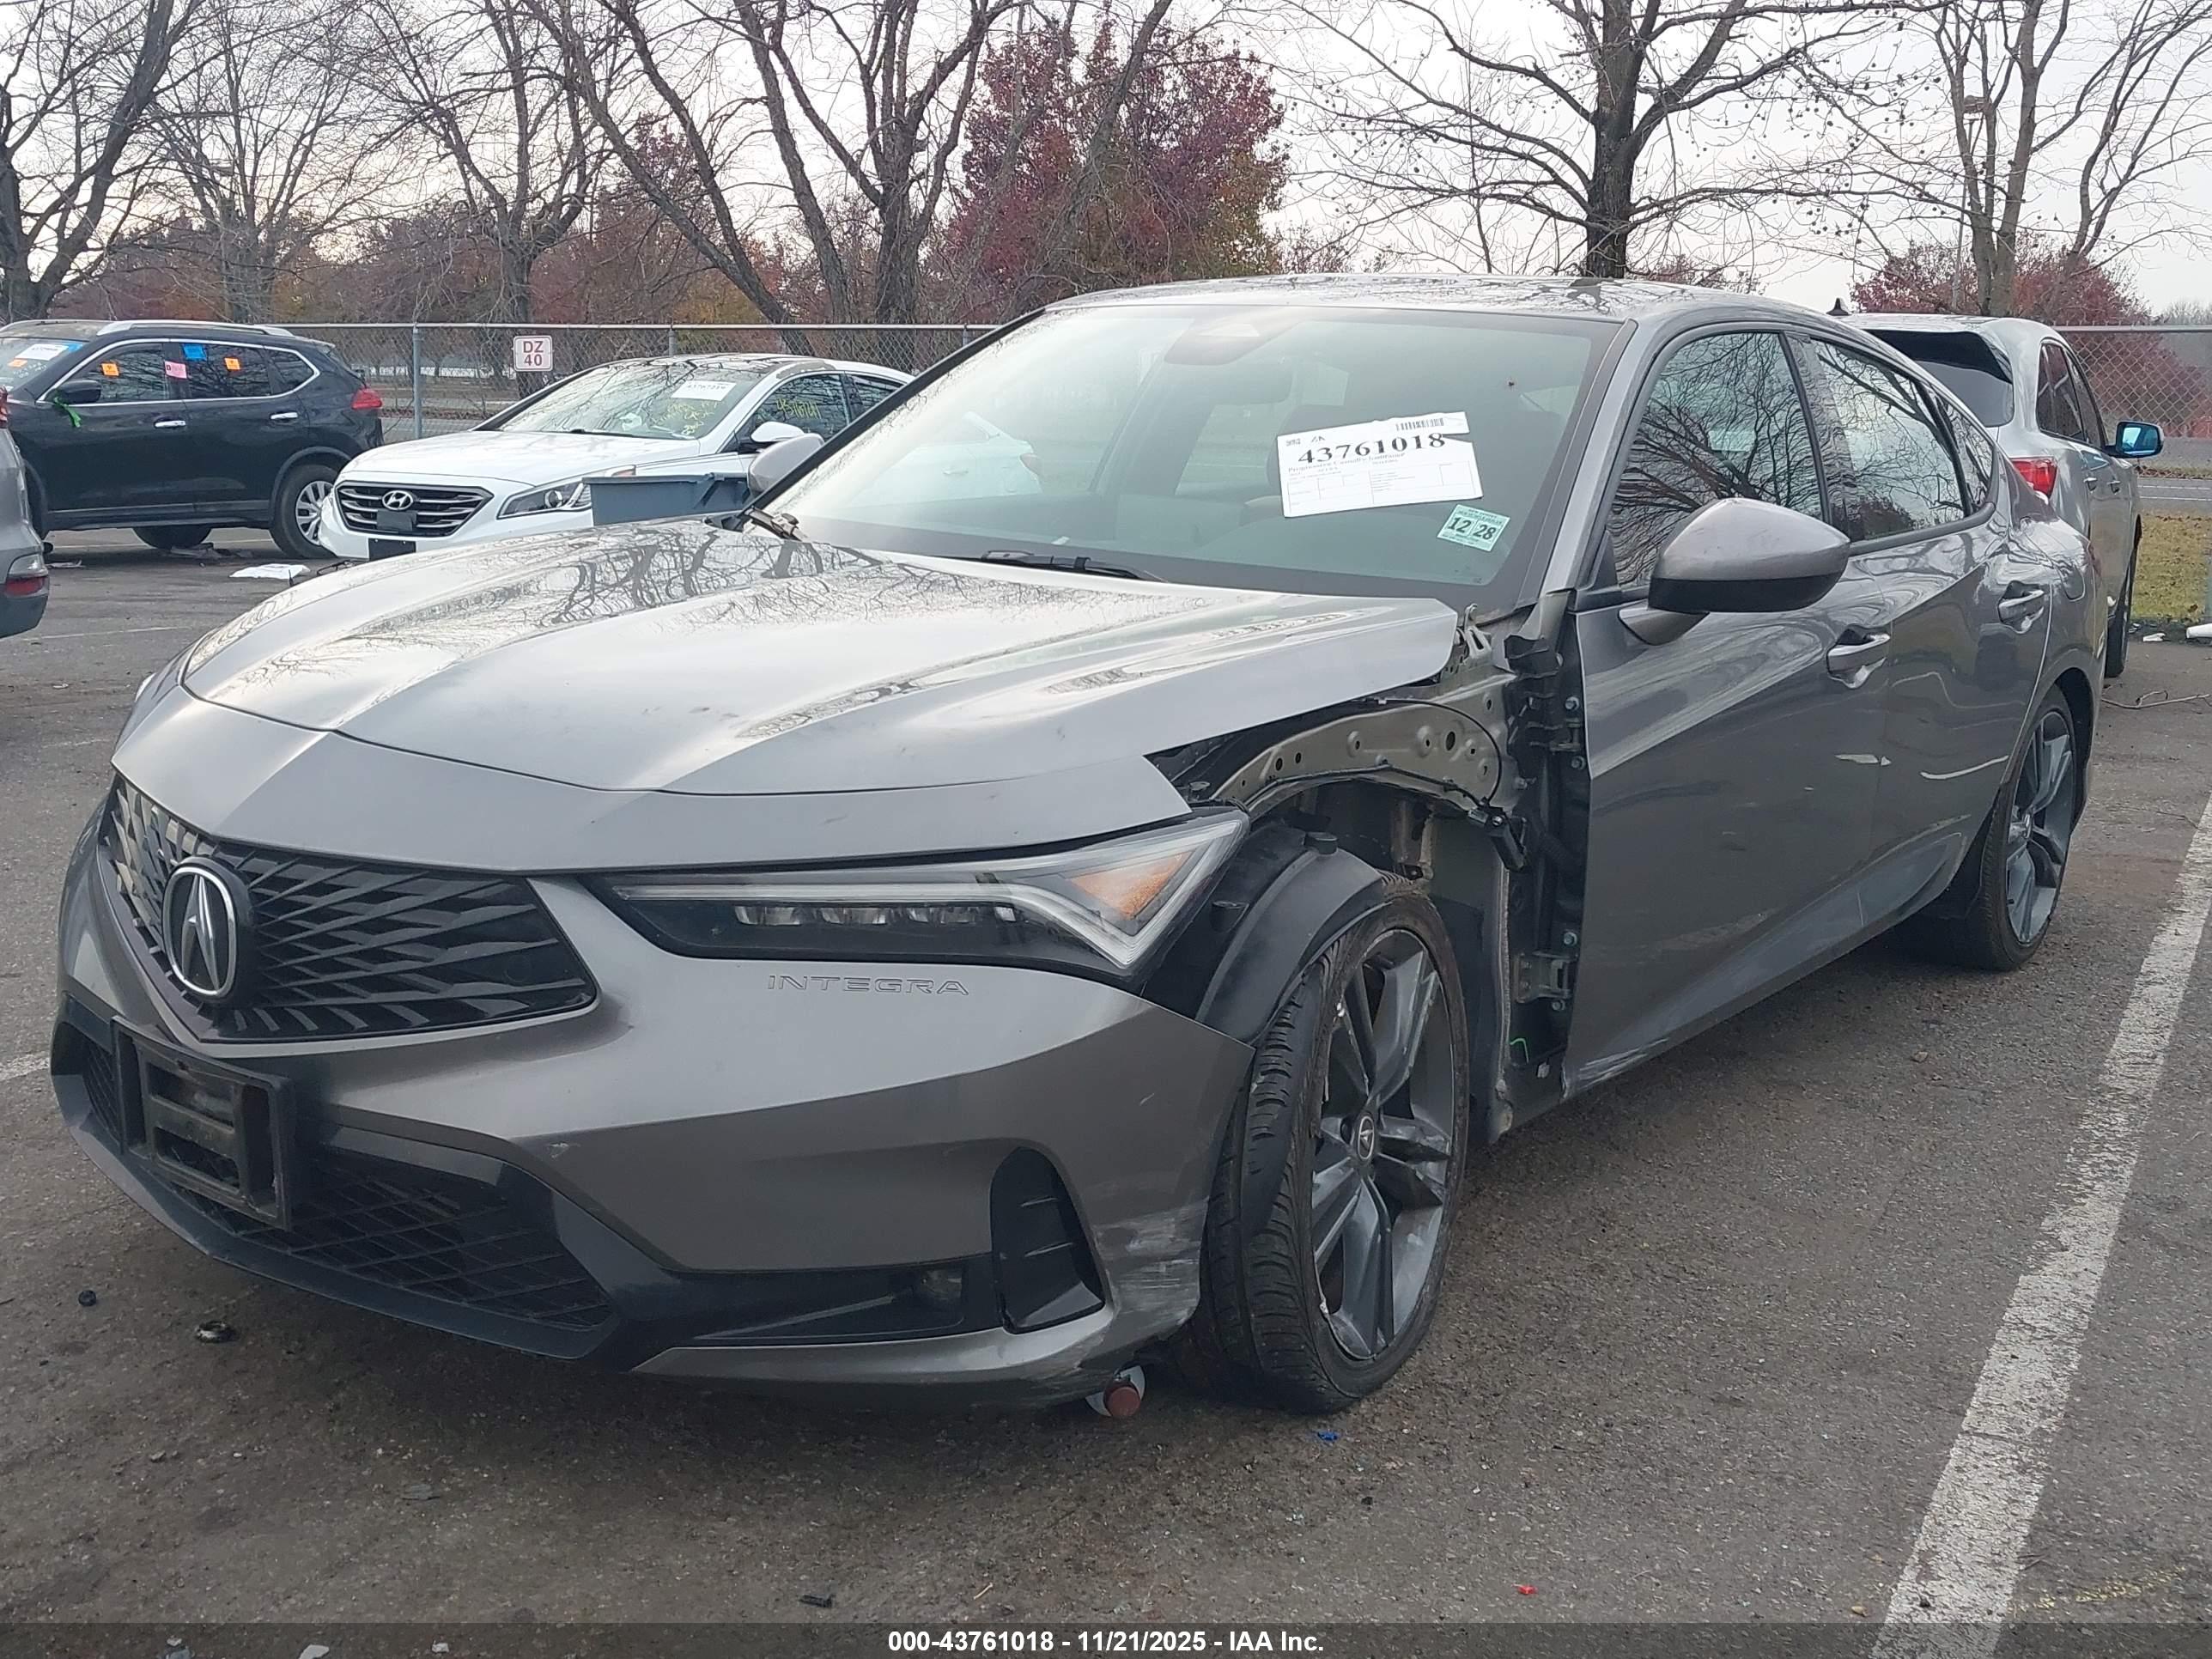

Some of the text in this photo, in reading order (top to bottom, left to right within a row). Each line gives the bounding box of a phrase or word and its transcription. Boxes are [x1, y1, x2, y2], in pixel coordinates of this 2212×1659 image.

[523, 341, 544, 353] DZ
[524, 355, 543, 366] 40
[1298, 433, 1445, 464] 43761018
[1448, 517, 1471, 533] 12
[1473, 524, 1497, 540] 28
[768, 975, 969, 995] INTEGRA
